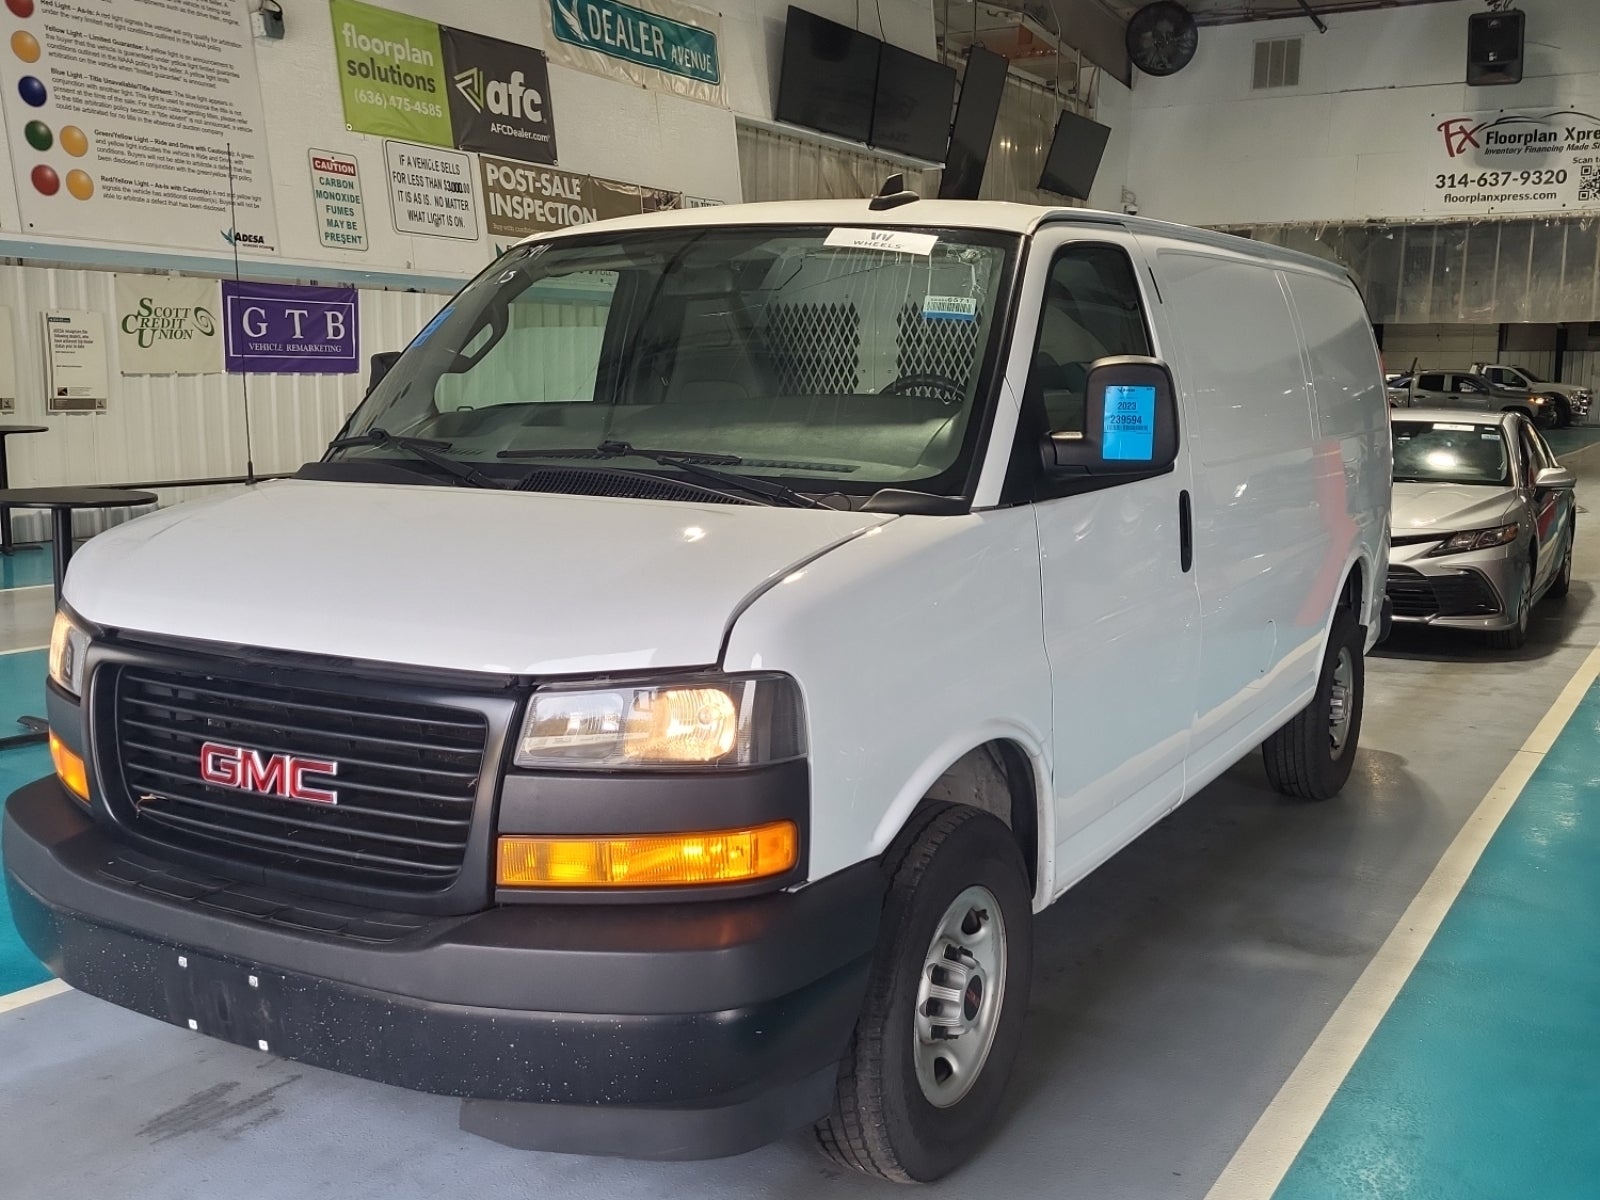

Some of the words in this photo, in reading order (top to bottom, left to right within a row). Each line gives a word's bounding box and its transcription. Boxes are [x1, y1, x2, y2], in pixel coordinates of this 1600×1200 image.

[54, 2, 71, 11] Light
[43, 24, 64, 33] Yellow
[65, 28, 82, 39] Light
[88, 33, 111, 43] Limited
[587, 3, 667, 61] DEALER
[671, 44, 713, 74] AVENUE
[342, 22, 433, 67] floorplan
[50, 67, 65, 75] Blue
[66, 70, 82, 80] Light
[88, 74, 101, 82] Title
[347, 57, 436, 94] solutions
[354, 88, 387, 110] (636)
[389, 95, 443, 118] 475-4585
[486, 70, 542, 122] afc
[94, 128, 132, 140] Green/Yellow
[133, 135, 148, 144] Light
[490, 122, 549, 142] AFCDealer.com
[1486, 128, 1557, 145] Floorplan
[1484, 147, 1522, 155] Inventory
[1524, 145, 1564, 153] Financing
[1566, 142, 1589, 151] Made
[314, 160, 355, 174] CAUTION
[399, 154, 405, 166] IF
[407, 156, 412, 168] A
[412, 156, 440, 172] VEHICLE
[441, 161, 461, 175] SELLS
[1572, 156, 1593, 164] Scan
[100, 175, 132, 184] Red/Yellow
[134, 179, 149, 188] Light
[319, 176, 354, 190] CARBON
[392, 171, 407, 184] FOR
[407, 174, 424, 187] LESS
[425, 176, 442, 190] THAN
[486, 163, 581, 200] POST-SALE
[1435, 169, 1568, 189] 314-637-9320
[315, 189, 361, 205] MONOXIDE
[398, 190, 403, 202] IT
[405, 191, 412, 203] IS
[413, 193, 421, 205] AS
[423, 194, 432, 206] IS.
[434, 196, 444, 208] NO
[445, 197, 470, 211] MATTER
[1444, 190, 1557, 204] floorplanxpress.com
[326, 205, 355, 217] FUMES
[489, 192, 598, 226] INSPECTION
[326, 219, 344, 229] MAY
[347, 221, 358, 231] BE
[407, 210, 425, 222] WHAT
[427, 213, 446, 226] LIGHT
[446, 213, 453, 226] IS
[454, 216, 466, 228] ON.
[235, 232, 264, 243] ADESA
[324, 232, 362, 244] PRESENT
[853, 240, 904, 249] WHEELS
[137, 297, 191, 318] SCOTT
[121, 314, 186, 334] CREDIT
[242, 306, 268, 338] G
[284, 309, 308, 339] T
[324, 310, 346, 340] B
[137, 328, 194, 349] UNION
[248, 343, 283, 351] VEHICLE
[286, 344, 341, 352] REMARKETING
[1118, 402, 1136, 410] 2023
[1110, 415, 1142, 425] 239594
[201, 741, 338, 805] GMC
